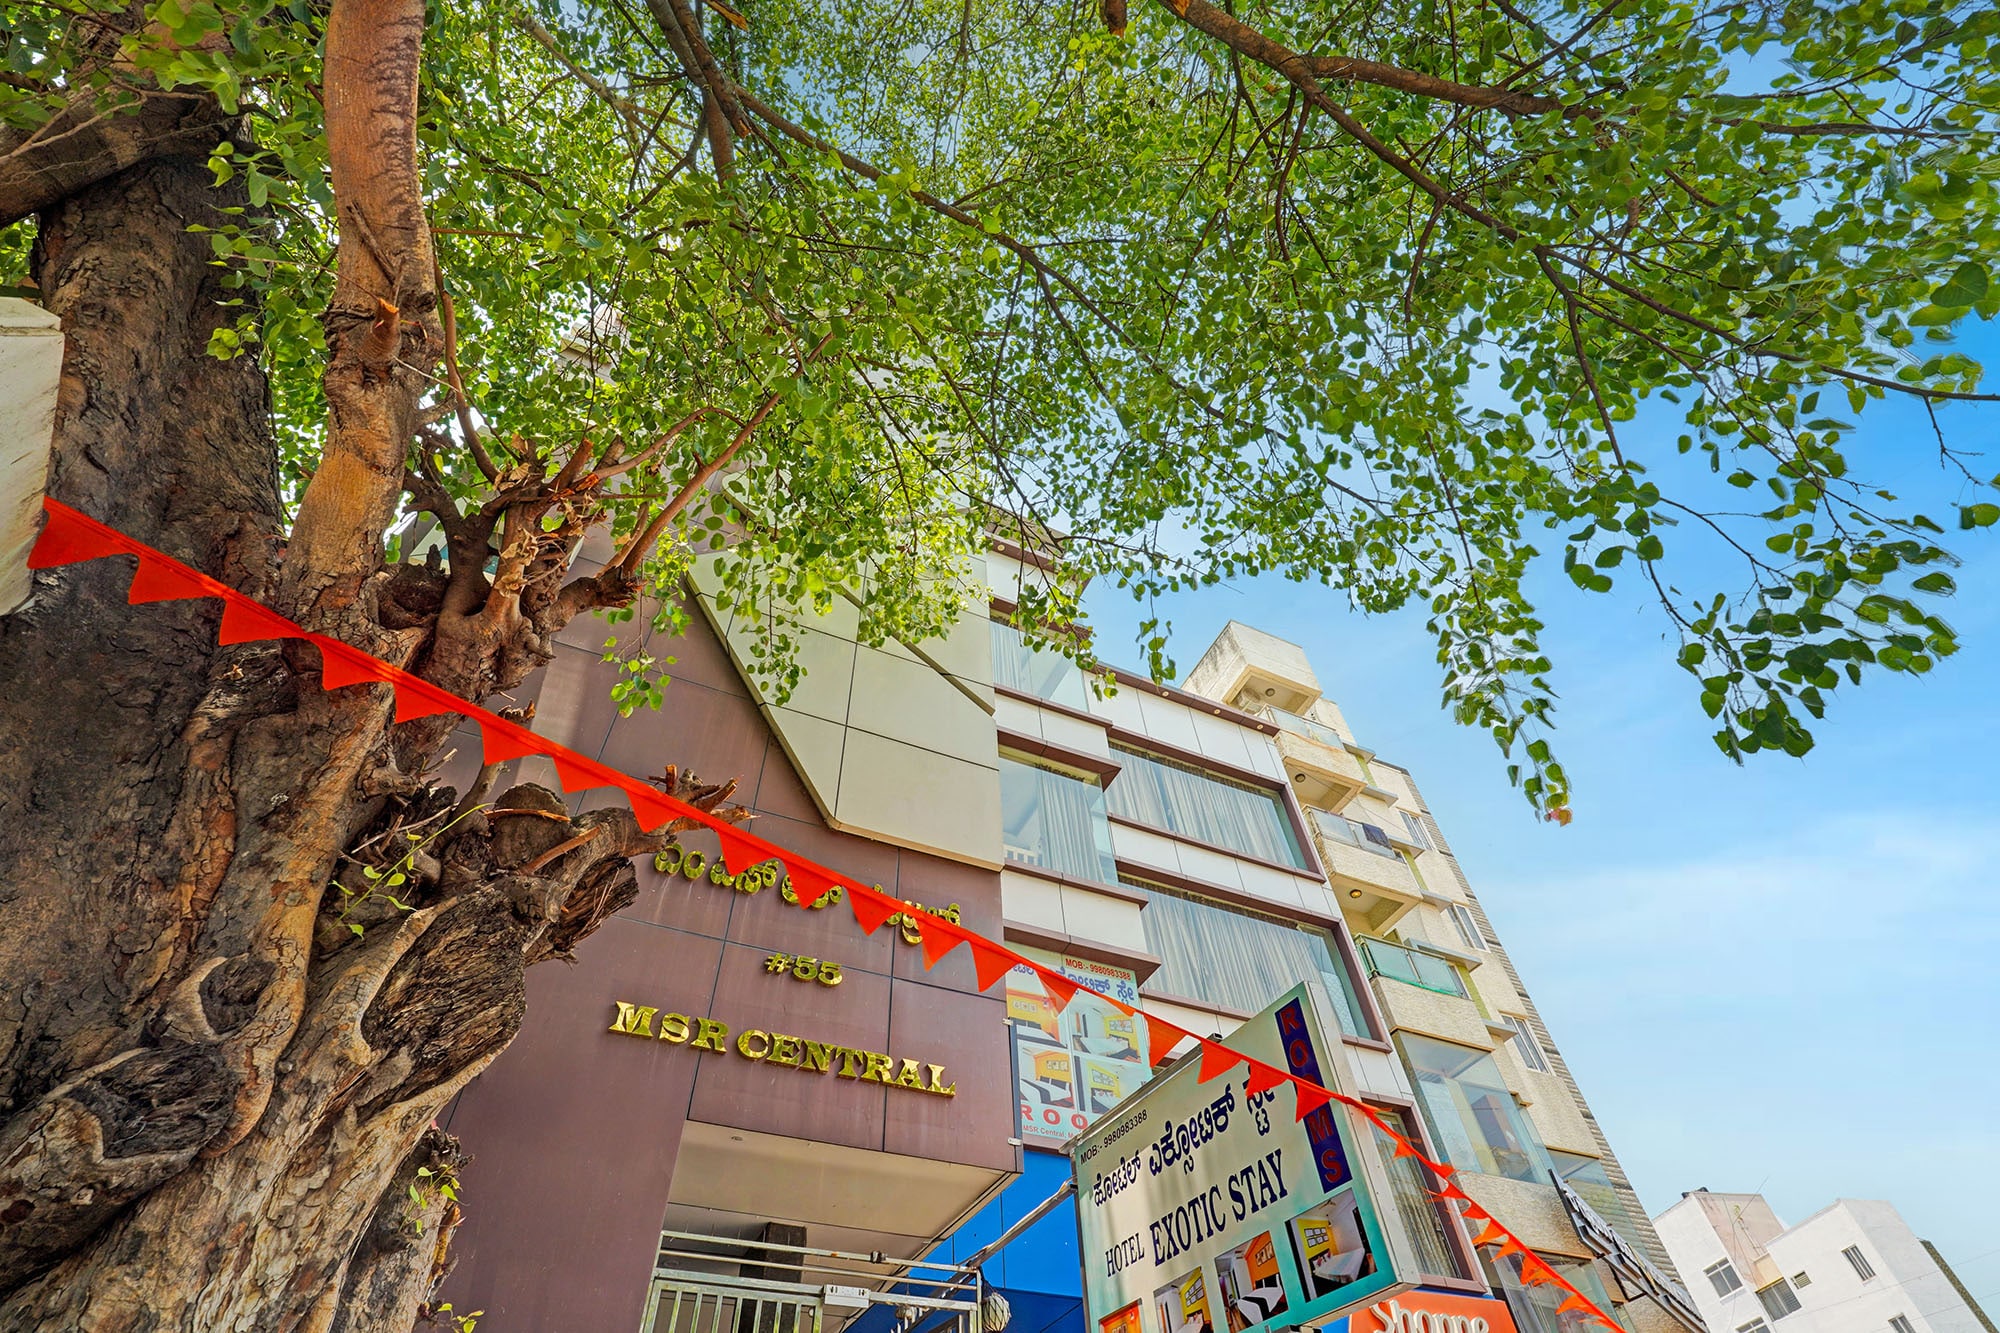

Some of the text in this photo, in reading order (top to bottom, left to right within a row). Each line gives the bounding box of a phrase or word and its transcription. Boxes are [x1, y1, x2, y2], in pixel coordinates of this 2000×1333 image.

[764, 952, 843, 988] #55
[607, 1000, 957, 1099] MSR CENTRAL
[1023, 1124, 1039, 1134] MSR
[1103, 1109, 1148, 1148] 9980983388
[1279, 1006, 1343, 1183] ROMS
[1105, 1148, 1288, 1278] HOTEL EXOTIC STAY
